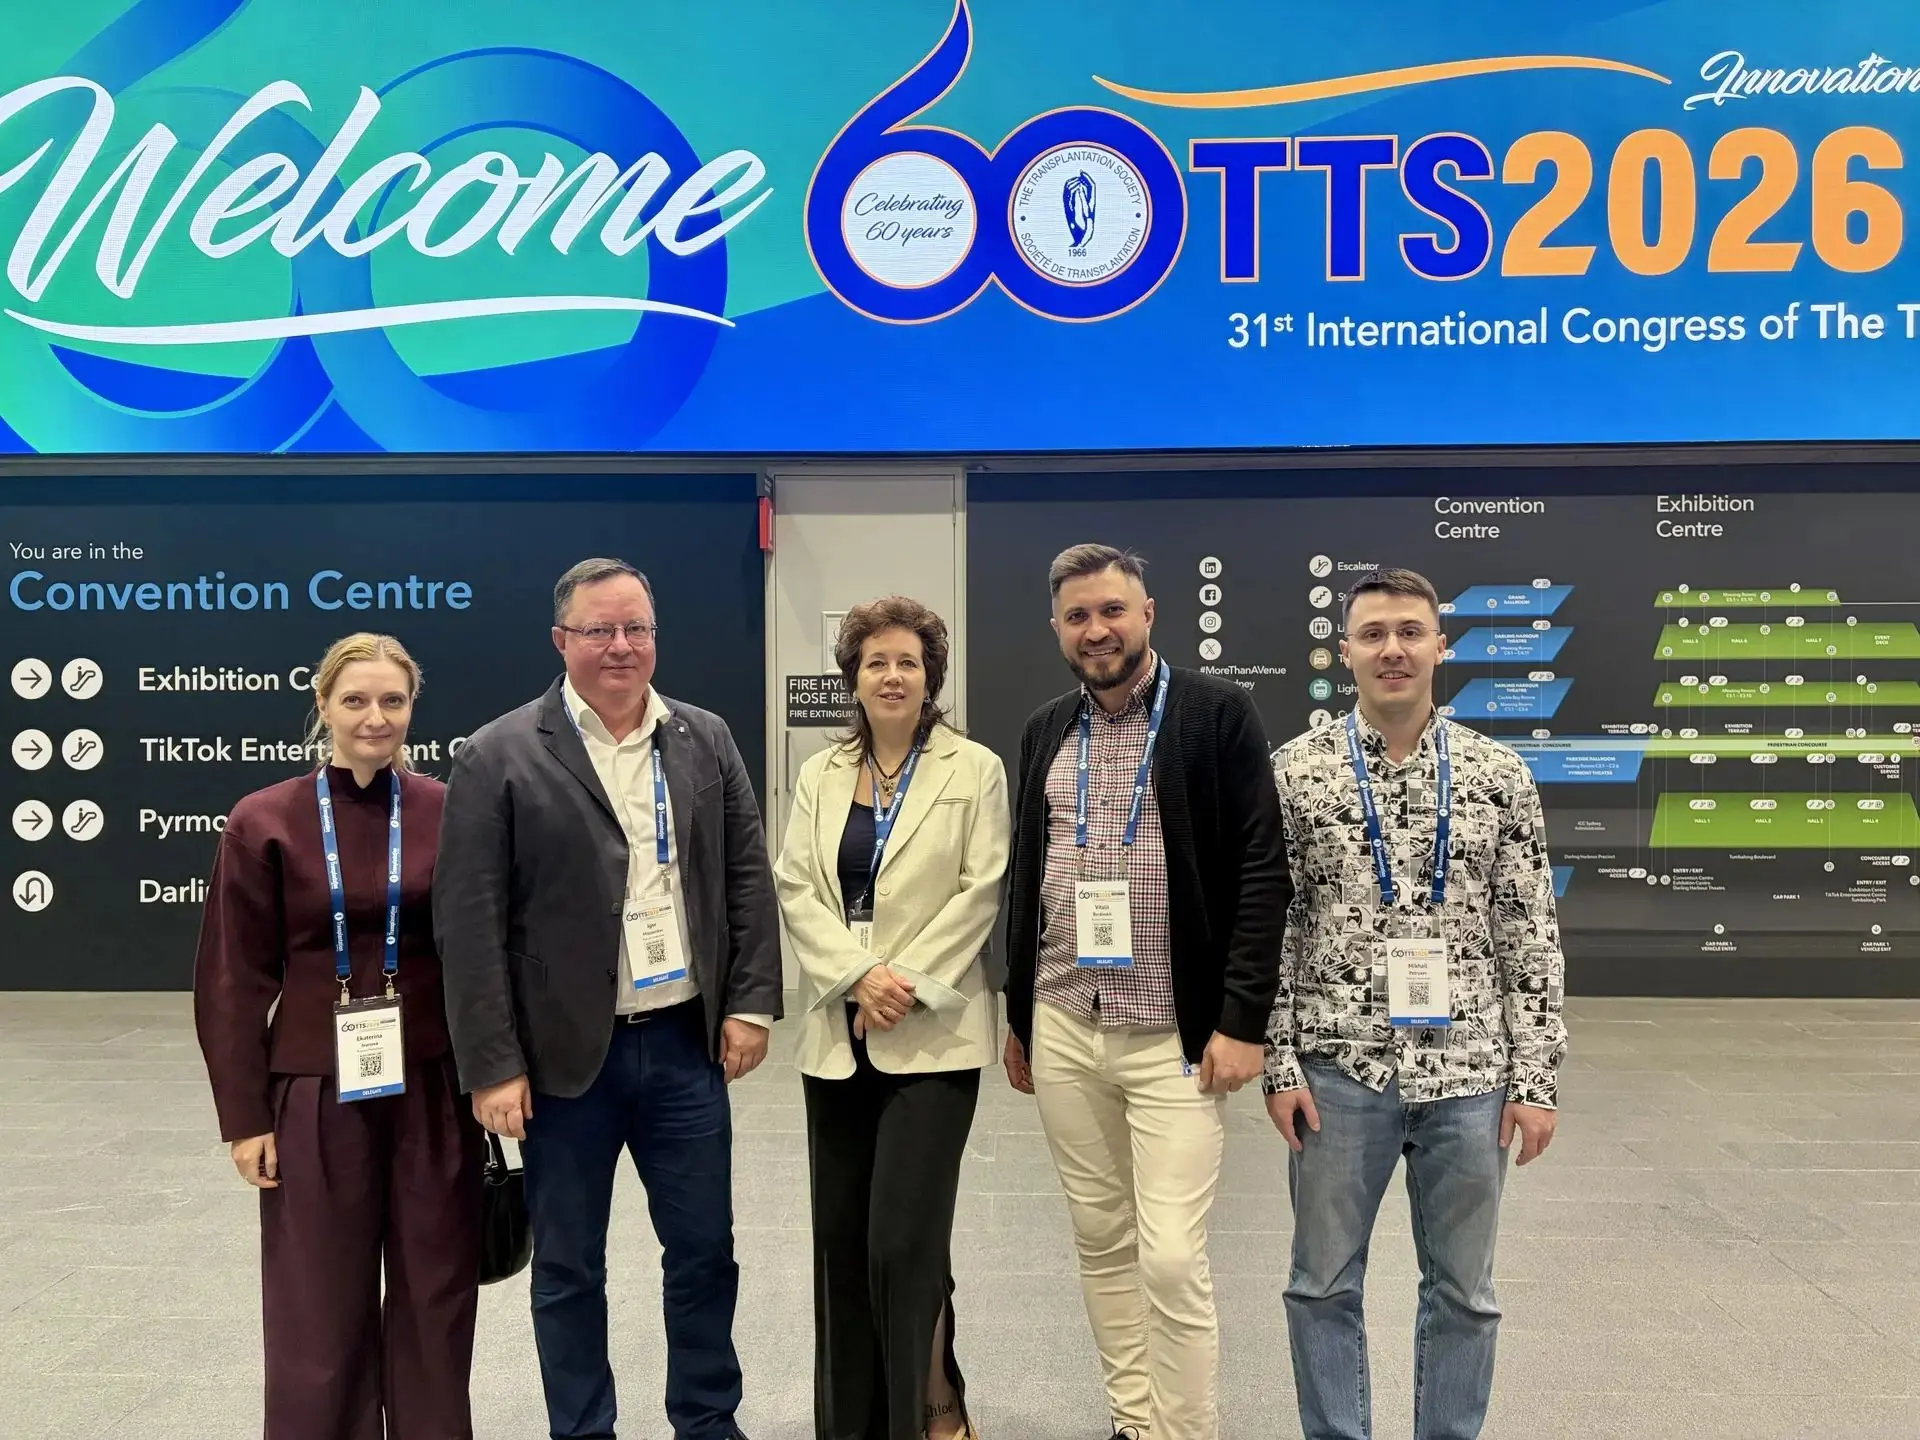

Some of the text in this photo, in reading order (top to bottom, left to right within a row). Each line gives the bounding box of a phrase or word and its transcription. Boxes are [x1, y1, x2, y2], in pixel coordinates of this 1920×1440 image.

[1019, 151, 1142, 206] THE TRANSPLANTATION SOCIETY
[0, 76, 774, 302] Welcome
[855, 192, 964, 219] Celebrating
[866, 221, 954, 247] 60 years
[1050, 263, 1066, 276] DE
[1067, 227, 1141, 278] TRANSPLANTATION
[1068, 248, 1087, 257] 1966
[1228, 311, 1294, 348] 31st
[1307, 307, 1548, 347] International
[1562, 308, 1746, 352] Congress
[1759, 302, 1801, 340] of
[1810, 302, 1885, 339] The
[1435, 497, 1545, 514] Convention
[1657, 495, 1755, 513] Exhibition
[1435, 521, 1500, 539] Centre
[1656, 520, 1723, 538] Centre
[9, 541, 144, 559] You are in the
[1337, 561, 1379, 571] Escalator
[9, 570, 473, 611] Convention Centre
[139, 666, 279, 691] Exhibition
[1200, 665, 1287, 675] #MoreThanAVenue
[789, 679, 818, 690] FIRE
[789, 692, 827, 704] HOSE
[789, 710, 808, 718] FIRE
[140, 736, 232, 761] TikTok
